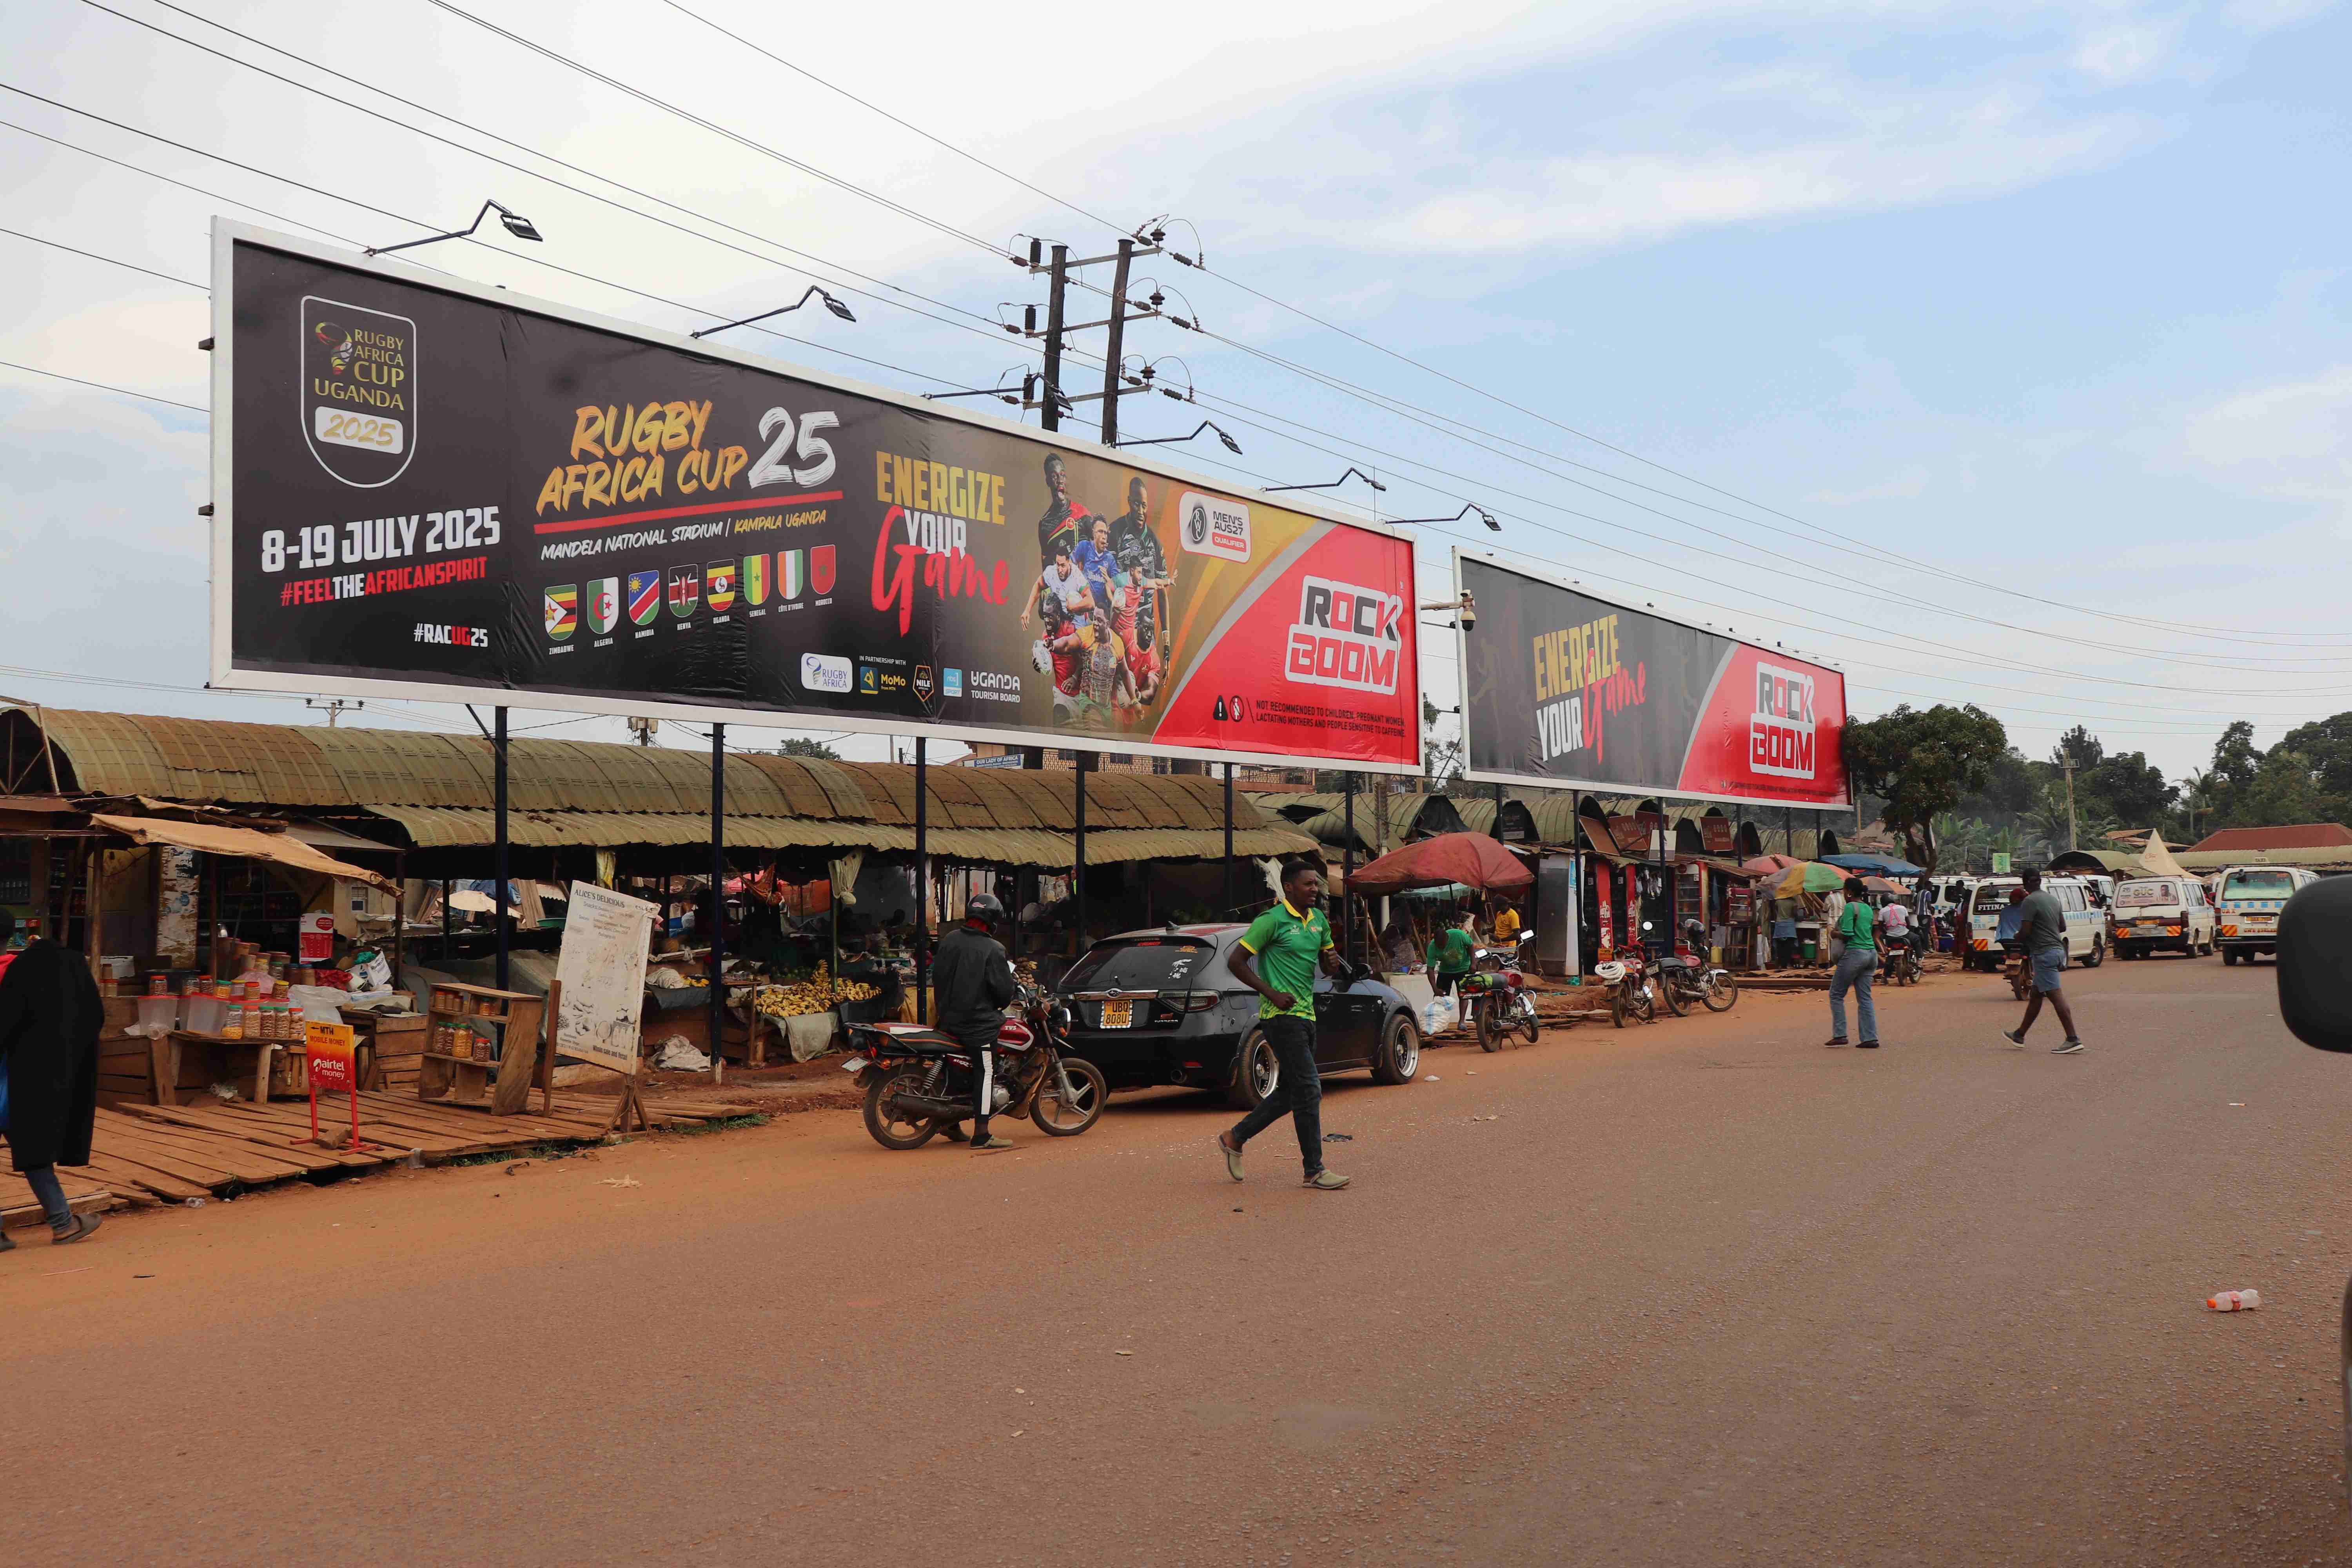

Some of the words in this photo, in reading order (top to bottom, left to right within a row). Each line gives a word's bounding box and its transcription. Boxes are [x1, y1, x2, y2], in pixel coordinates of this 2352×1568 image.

[354, 329, 404, 350] RUGBY
[354, 345, 404, 367] AFRICA
[354, 361, 404, 388] CUP
[315, 378, 404, 411] UGANDA
[323, 414, 396, 446] 2025
[570, 399, 713, 461] RUGBY
[748, 406, 840, 489] 25
[535, 456, 664, 516] AFRICA
[676, 446, 748, 494] CUP
[877, 451, 1005, 525] ENERGIZE
[1213, 511, 1243, 526] MEN'S
[1214, 522, 1243, 535] AUS27
[262, 524, 334, 573] 8-19
[342, 514, 419, 564] JULY
[426, 506, 500, 553] 2025
[541, 539, 601, 560] MANDELA
[605, 529, 668, 553] NATIONAL
[671, 519, 723, 544] STADIUM
[734, 515, 782, 533] KAMPALA
[785, 510, 826, 528] UGANDA
[904, 509, 966, 559] YOUR
[1214, 536, 1244, 548] QUALIFIER
[281, 556, 487, 606] #FEELTHEAFRICANSPIRIT
[871, 505, 1009, 637] Game
[815, 598, 832, 606] MOROCCO
[713, 615, 730, 624] UGANDA
[749, 609, 766, 617] SENEGAL
[1304, 585, 1398, 641] ROCK
[414, 623, 488, 647] #RACUG25
[635, 629, 654, 639] NAMIBIA
[677, 622, 691, 630] KENYA
[549, 645, 574, 655] ZIMBABWE
[594, 637, 613, 647] ALGERIA
[1290, 633, 1395, 687] BOOM
[1534, 614, 1621, 702] ENERGIZE
[822, 668, 848, 680] RUGBY
[822, 678, 847, 688] AFRICA
[881, 674, 906, 686] MoMo
[916, 679, 930, 687] NILE
[970, 671, 1020, 691] UGANDA
[971, 690, 998, 702] TOURISM
[1000, 691, 1020, 702] BOARD
[1582, 648, 1646, 765] Game
[1759, 672, 1813, 723] ROCK
[1256, 700, 1268, 710] NOT
[1270, 702, 1315, 715] RECOMMENDED
[1316, 707, 1324, 716] TO
[1356, 711, 1384, 723] PREGNANT
[1256, 713, 1286, 724] LACTATING
[1288, 717, 1313, 726] MOTHERS
[1315, 719, 1326, 728] AND
[1327, 720, 1347, 730] PEOPLE
[1348, 722, 1374, 733] SENSITIVE
[1375, 726, 1381, 734] TO
[1536, 696, 1583, 762] YOUR
[1753, 722, 1813, 771] BOOM
[574, 889, 596, 900] ALICE'S
[597, 894, 624, 907] DELICIOUS
[1112, 1002, 1128, 1012] UBQ
[1106, 1014, 1127, 1024] 808U
[322, 1060, 345, 1071] airtel
[322, 1070, 345, 1080] money
